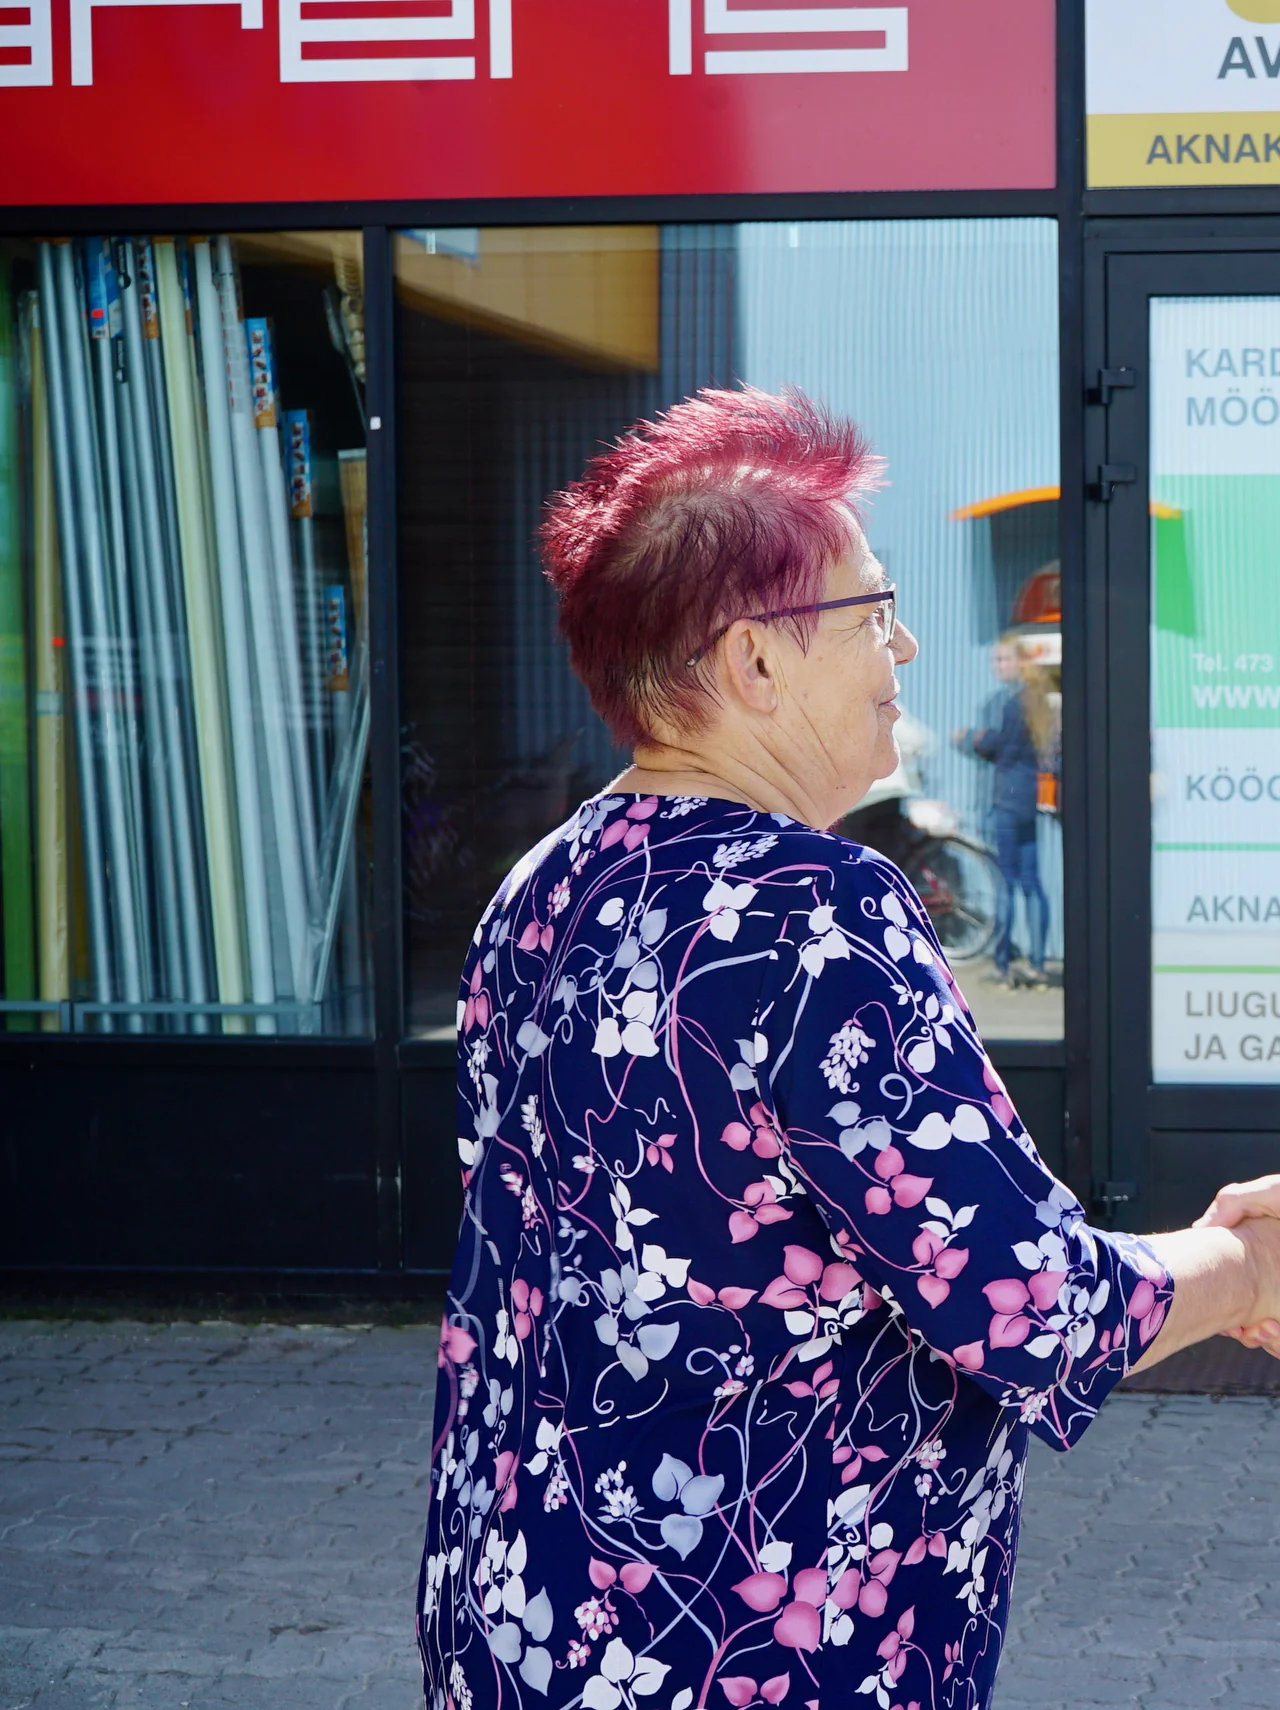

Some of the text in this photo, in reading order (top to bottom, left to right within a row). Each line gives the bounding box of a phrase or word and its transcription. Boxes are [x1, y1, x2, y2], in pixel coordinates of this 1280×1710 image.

[1193, 654, 1228, 672] Tel.
[1234, 653, 1274, 672] 473
[1184, 1035, 1227, 1061] JA
